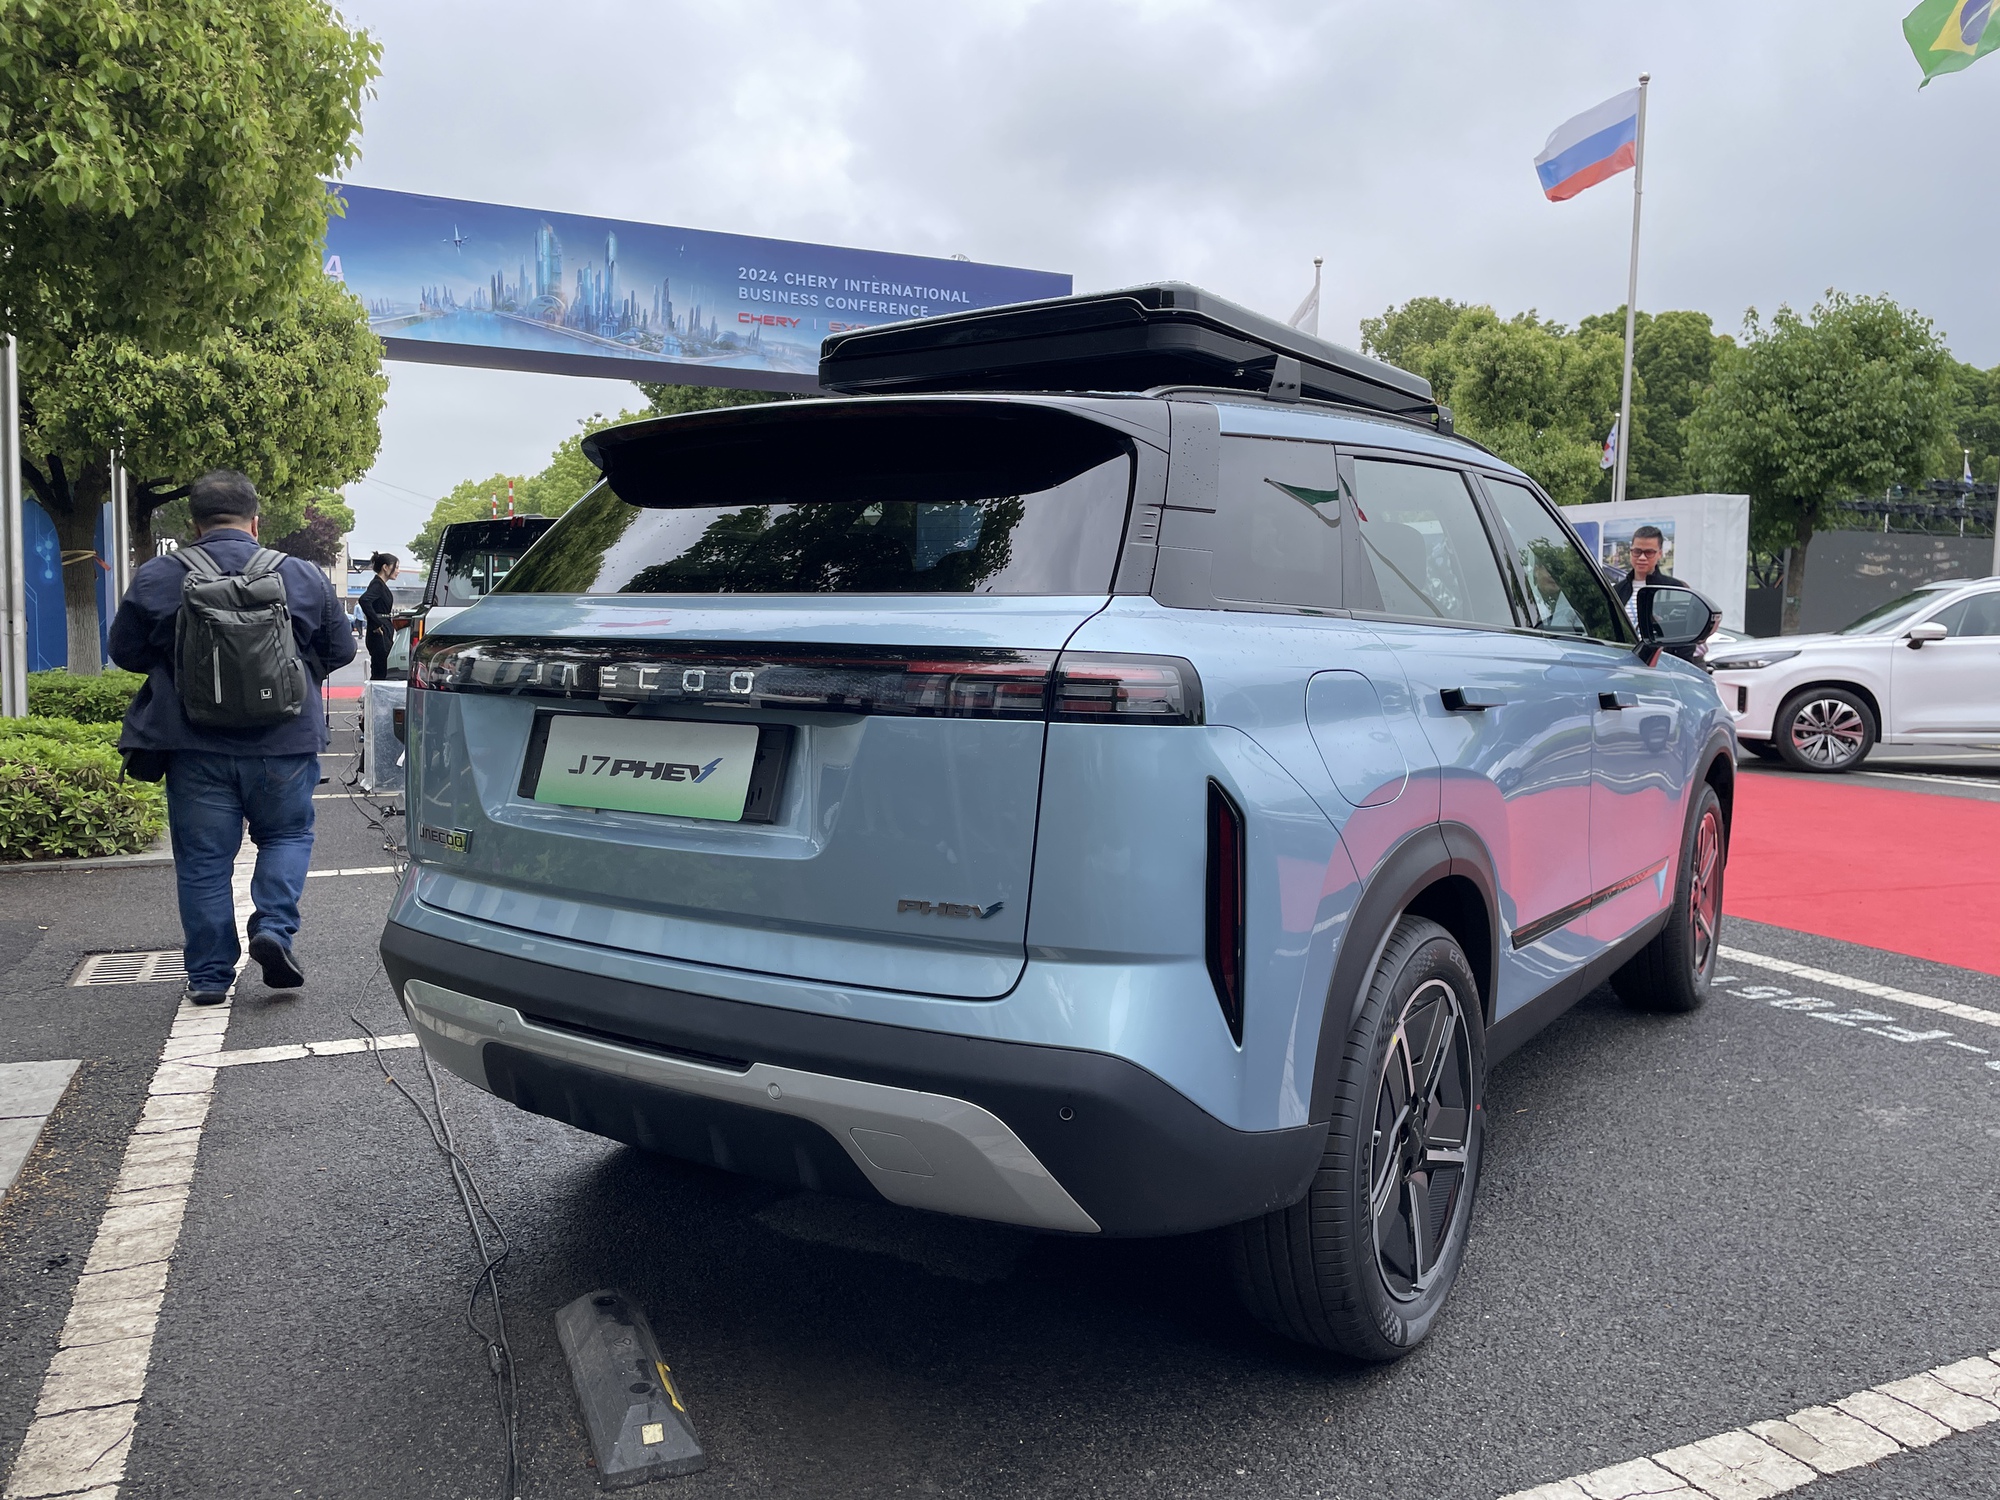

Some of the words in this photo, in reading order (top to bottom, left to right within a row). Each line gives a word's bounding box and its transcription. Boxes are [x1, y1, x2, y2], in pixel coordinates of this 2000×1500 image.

[738, 266, 778, 283] 2024
[784, 272, 839, 290] CHERY
[844, 278, 970, 304] INTERNATIONAL
[738, 286, 819, 307] BUSINESS
[825, 296, 929, 318] CONFERENCE
[738, 312, 801, 329] CHERY
[897, 899, 1005, 920] PHEV
